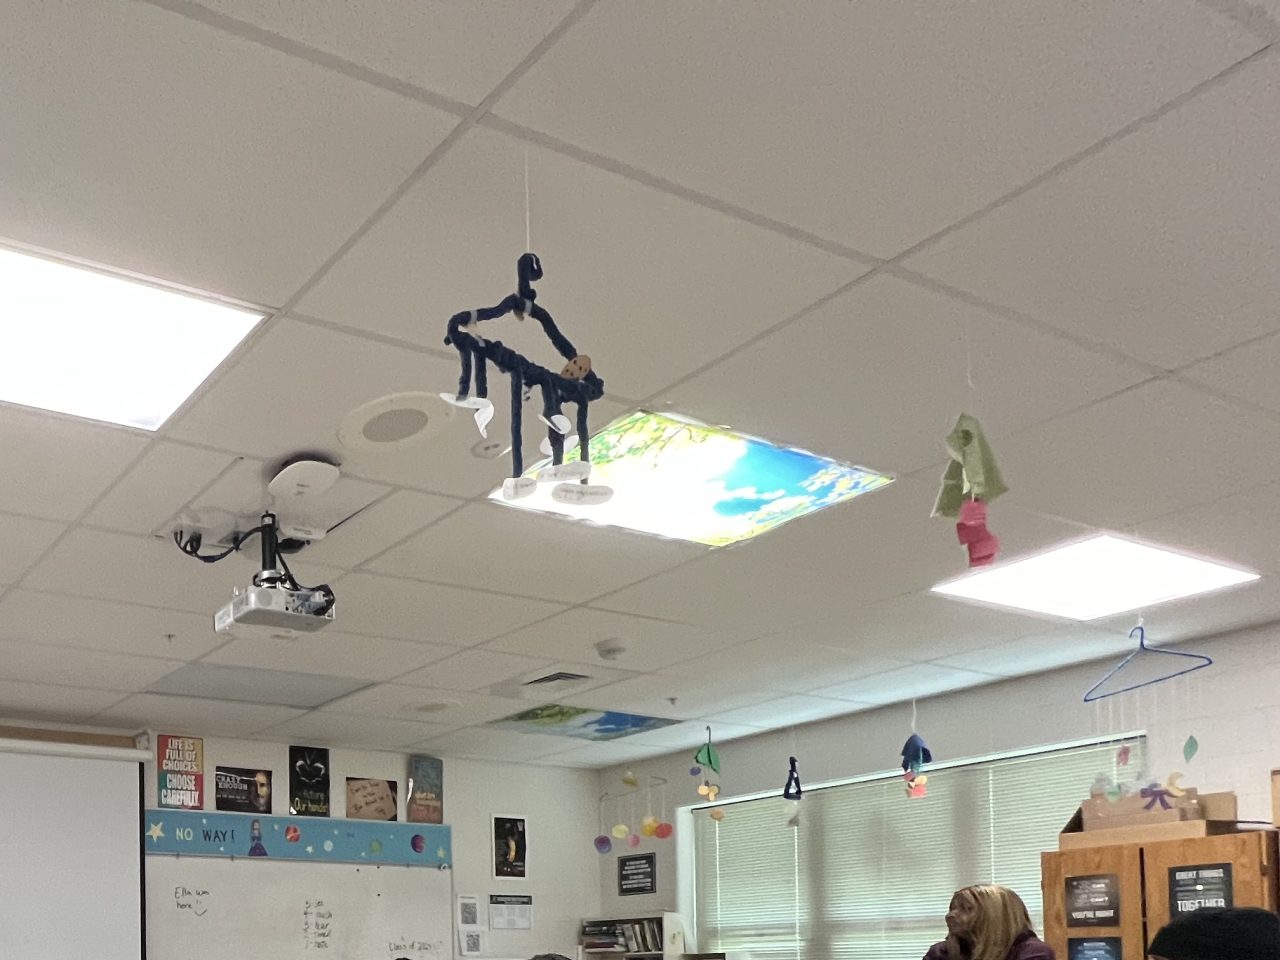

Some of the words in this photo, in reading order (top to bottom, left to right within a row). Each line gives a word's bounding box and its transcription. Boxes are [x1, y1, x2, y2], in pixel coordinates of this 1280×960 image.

[168, 738, 183, 750] LIFE
[184, 740, 194, 751] IS
[166, 749, 184, 760] FULL
[166, 773, 196, 791] CHOOSE
[176, 827, 193, 841] NO
